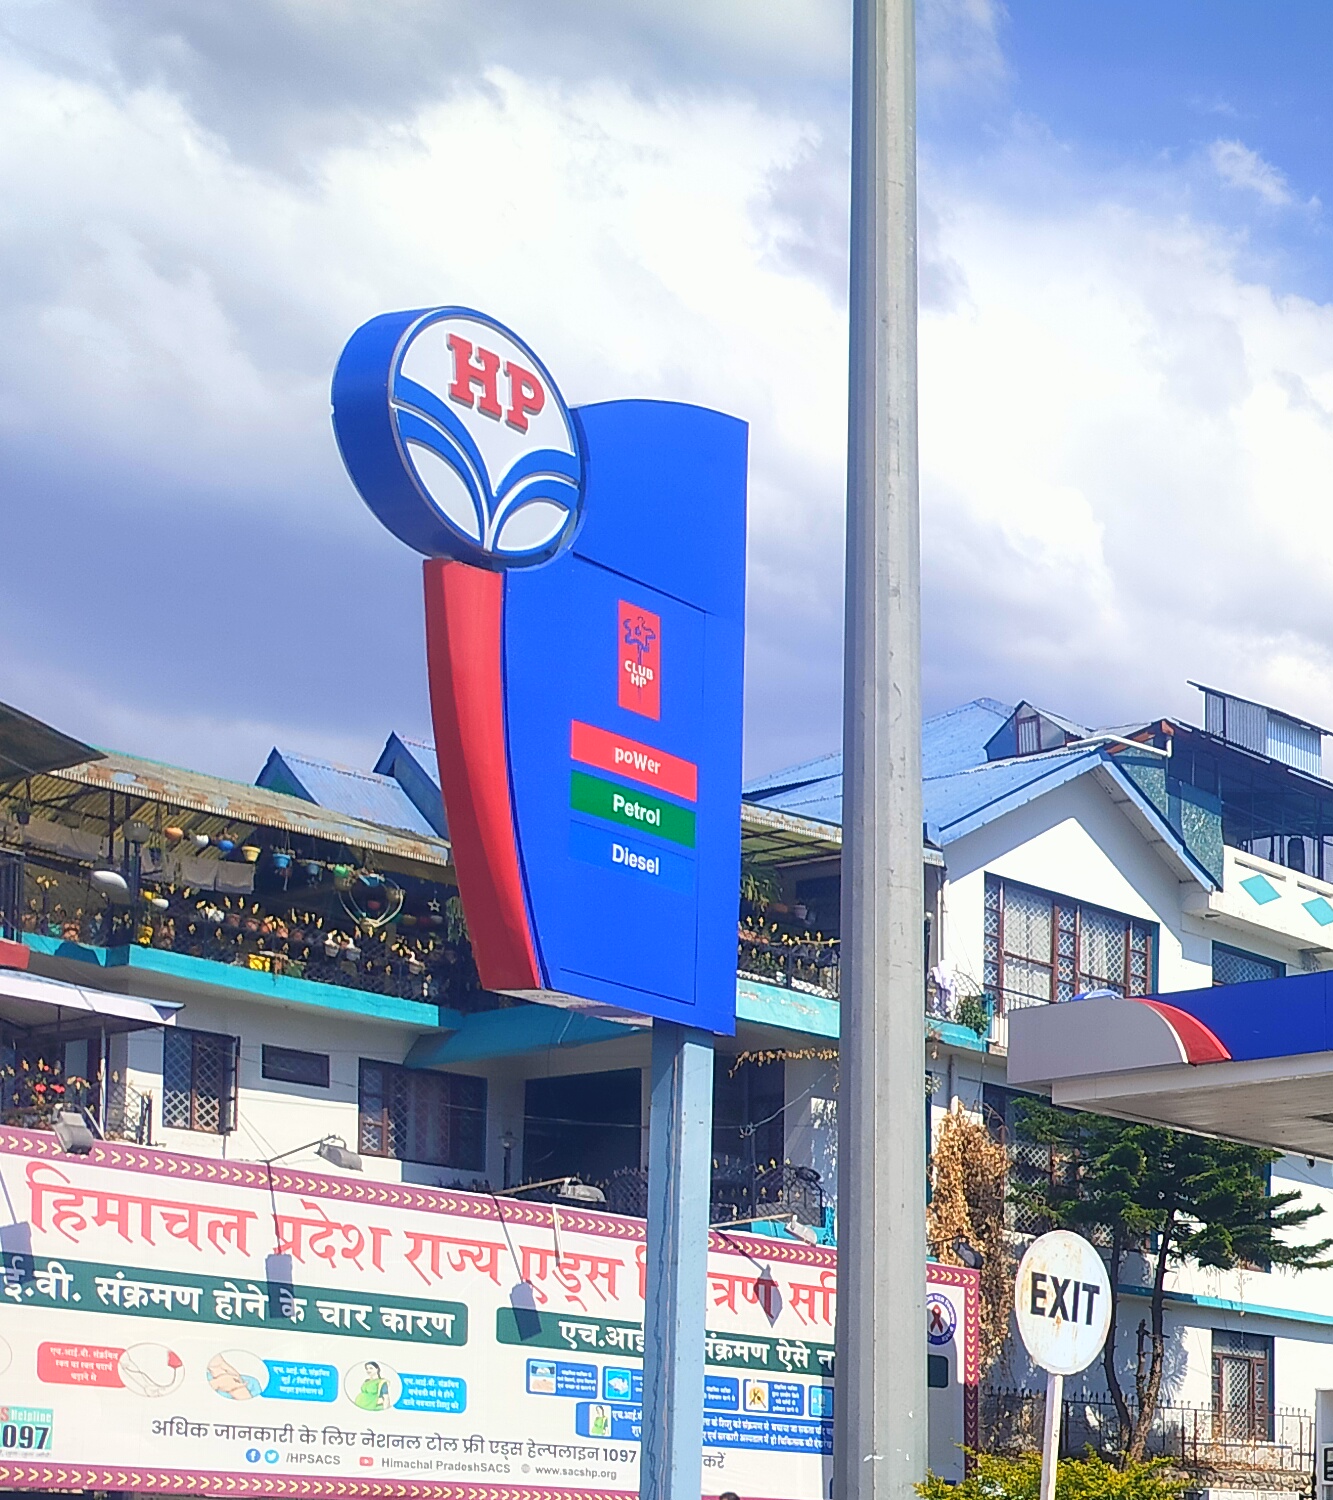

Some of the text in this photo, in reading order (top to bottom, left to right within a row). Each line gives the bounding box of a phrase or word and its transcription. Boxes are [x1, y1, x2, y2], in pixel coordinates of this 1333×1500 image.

[446, 333, 546, 435] HP
[625, 660, 653, 681] CLUB
[631, 672, 647, 688] HP
[613, 793, 660, 826] Petrol
[612, 843, 660, 876] Diesel
[26, 1161, 258, 1257] हिमाचल
[271, 1198, 392, 1273] प्रदेश
[404, 1230, 508, 1286] राज्य
[519, 1245, 625, 1312] एड्स
[95, 1271, 203, 1314] संक्रमण
[214, 1281, 269, 1320] होने
[280, 1288, 307, 1325] के
[316, 1300, 372, 1331] चार
[380, 1306, 455, 1338] कारण
[1031, 1271, 1100, 1326] EXIT
[776, 1339, 810, 1371] ऐसे
[2, 1425, 49, 1449] 097
[152, 1416, 210, 1438] अधिक
[214, 1423, 295, 1444] जानकारी
[298, 1425, 318, 1445] के
[321, 1426, 357, 1446] लिए
[360, 1429, 422, 1449] नेशनल
[425, 1433, 459, 1451] टोल
[462, 1434, 484, 1454] फ्री
[489, 1440, 523, 1460] एड्स
[526, 1438, 600, 1461] हेल्पलाइन
[603, 1448, 637, 1463] 1097
[286, 1453, 341, 1465] /HPSACS
[382, 1458, 433, 1470] Himachal
[535, 1466, 617, 1480] www.sacshp.org
